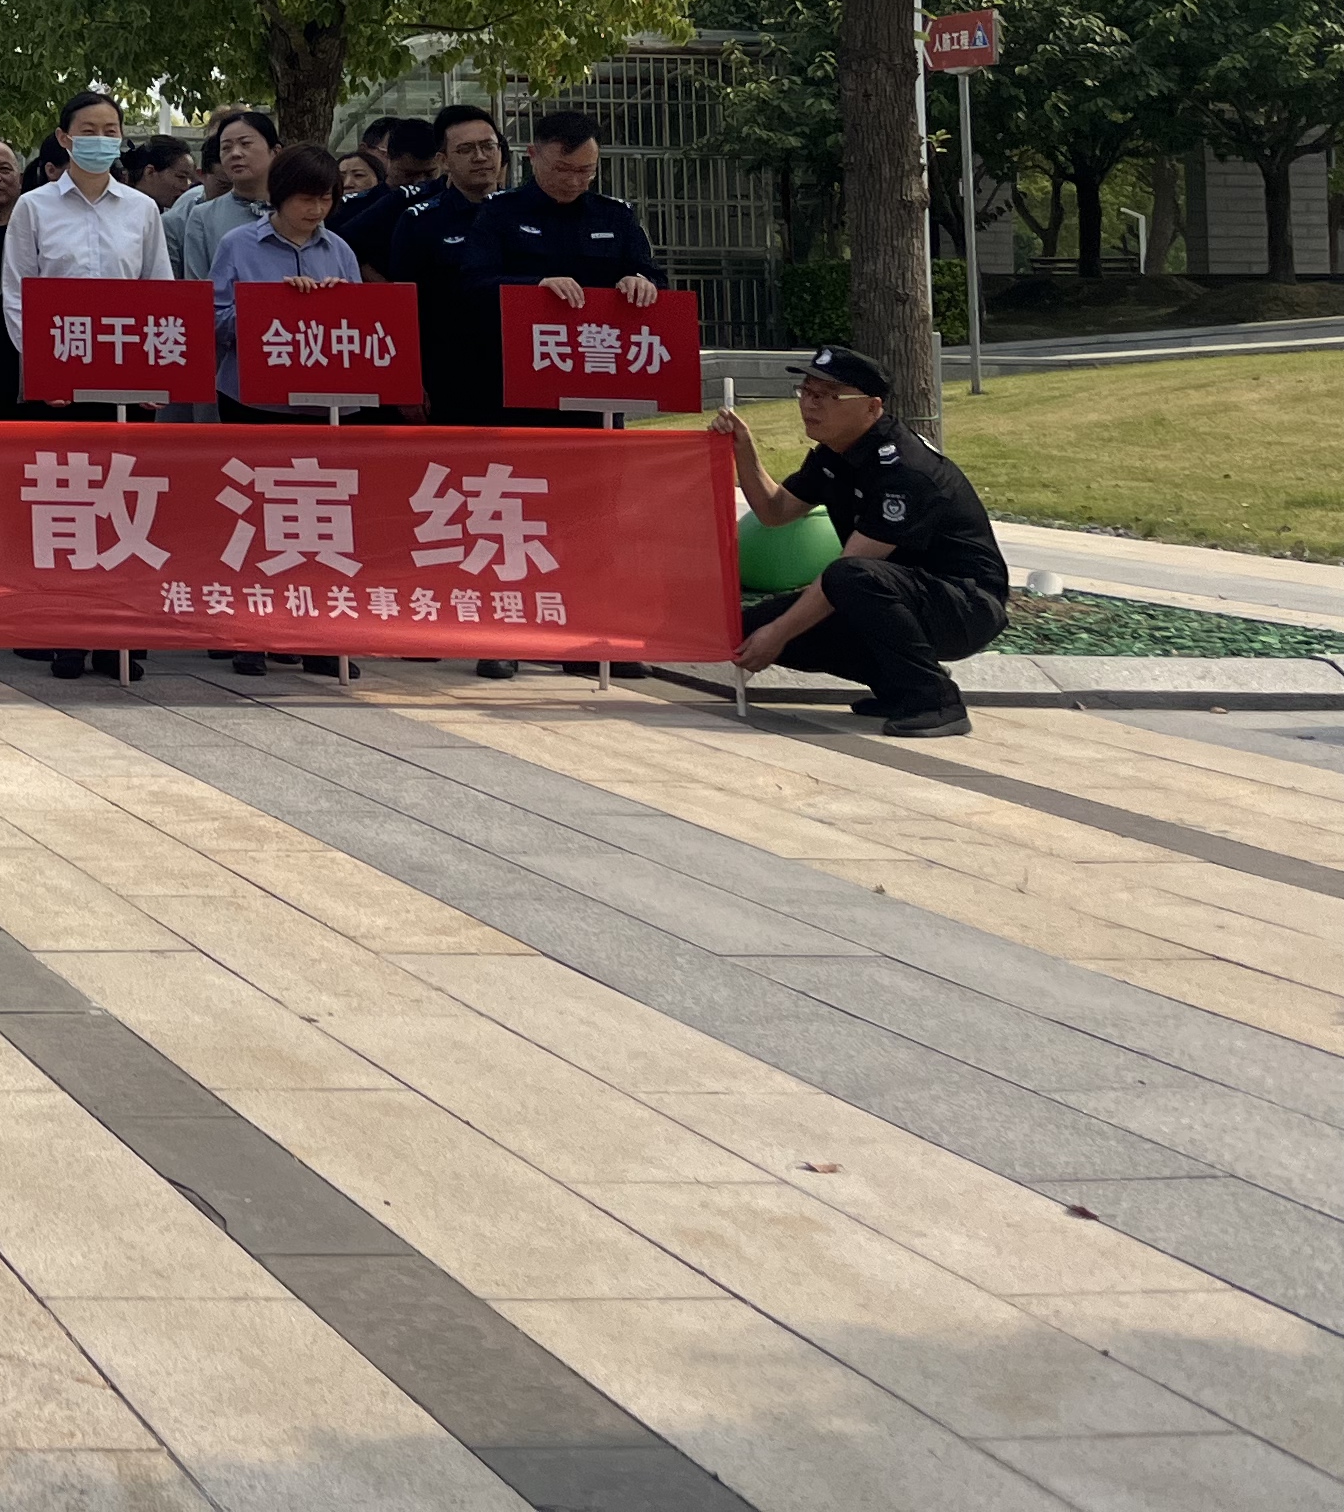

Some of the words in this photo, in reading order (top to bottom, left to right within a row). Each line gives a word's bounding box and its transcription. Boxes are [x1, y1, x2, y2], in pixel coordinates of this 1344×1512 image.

[50, 315, 188, 367] 调干楼
[261, 319, 397, 368] 会议中心
[532, 323, 672, 375] 民警办
[160, 580, 568, 626] 淮安市机关事务管理局
